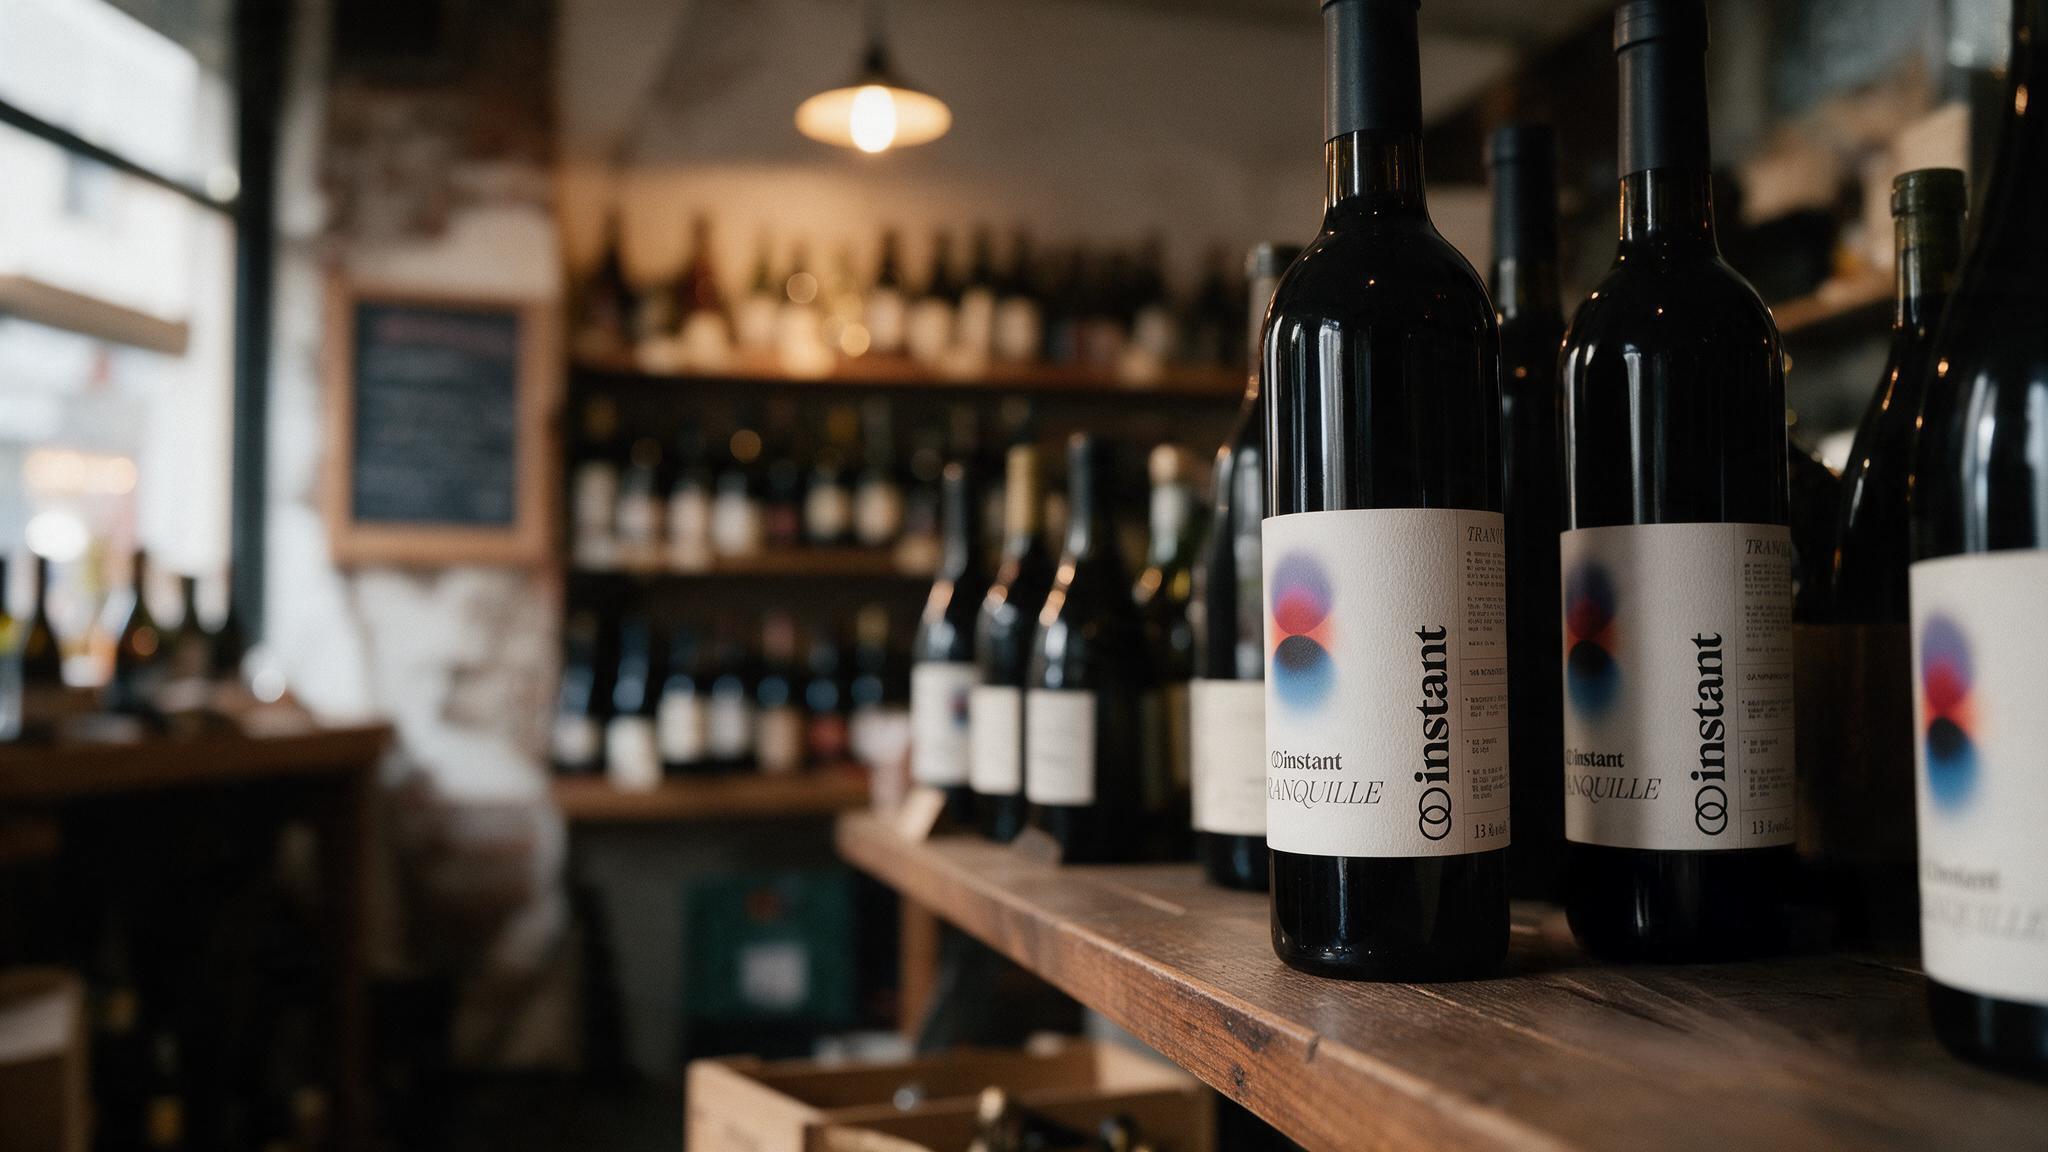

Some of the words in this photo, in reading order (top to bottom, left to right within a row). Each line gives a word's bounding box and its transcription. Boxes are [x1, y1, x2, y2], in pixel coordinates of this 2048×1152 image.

[1414, 625, 1449, 785] instant
[1690, 633, 1726, 783] instant
[1283, 750, 1343, 770] instant
[1574, 749, 1625, 768] instant
[1268, 777, 1384, 809] RANQUILLE
[1474, 823, 1486, 839] 13
[1752, 820, 1764, 835] 13
